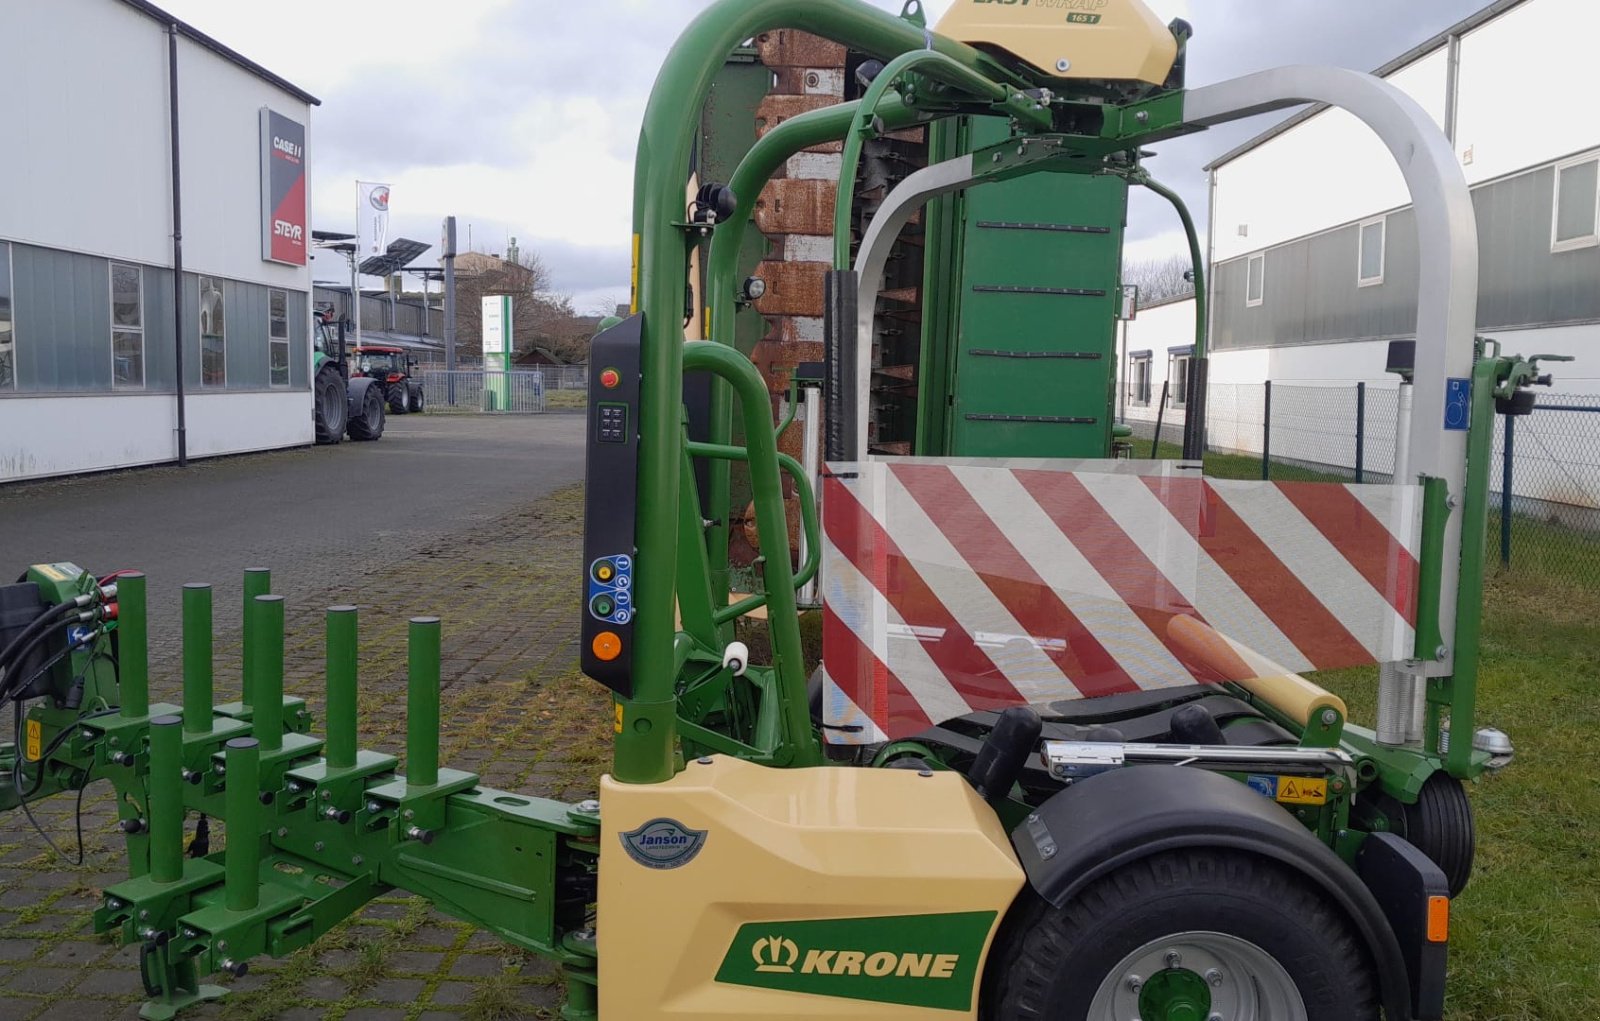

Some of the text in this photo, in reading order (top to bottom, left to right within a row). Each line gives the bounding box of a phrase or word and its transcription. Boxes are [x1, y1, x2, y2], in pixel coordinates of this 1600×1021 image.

[1072, 14, 1097, 23] 165 T
[273, 135, 294, 156] CASE
[274, 219, 302, 241] STEYR
[639, 834, 687, 845] Janson
[800, 949, 960, 978] KRONE
